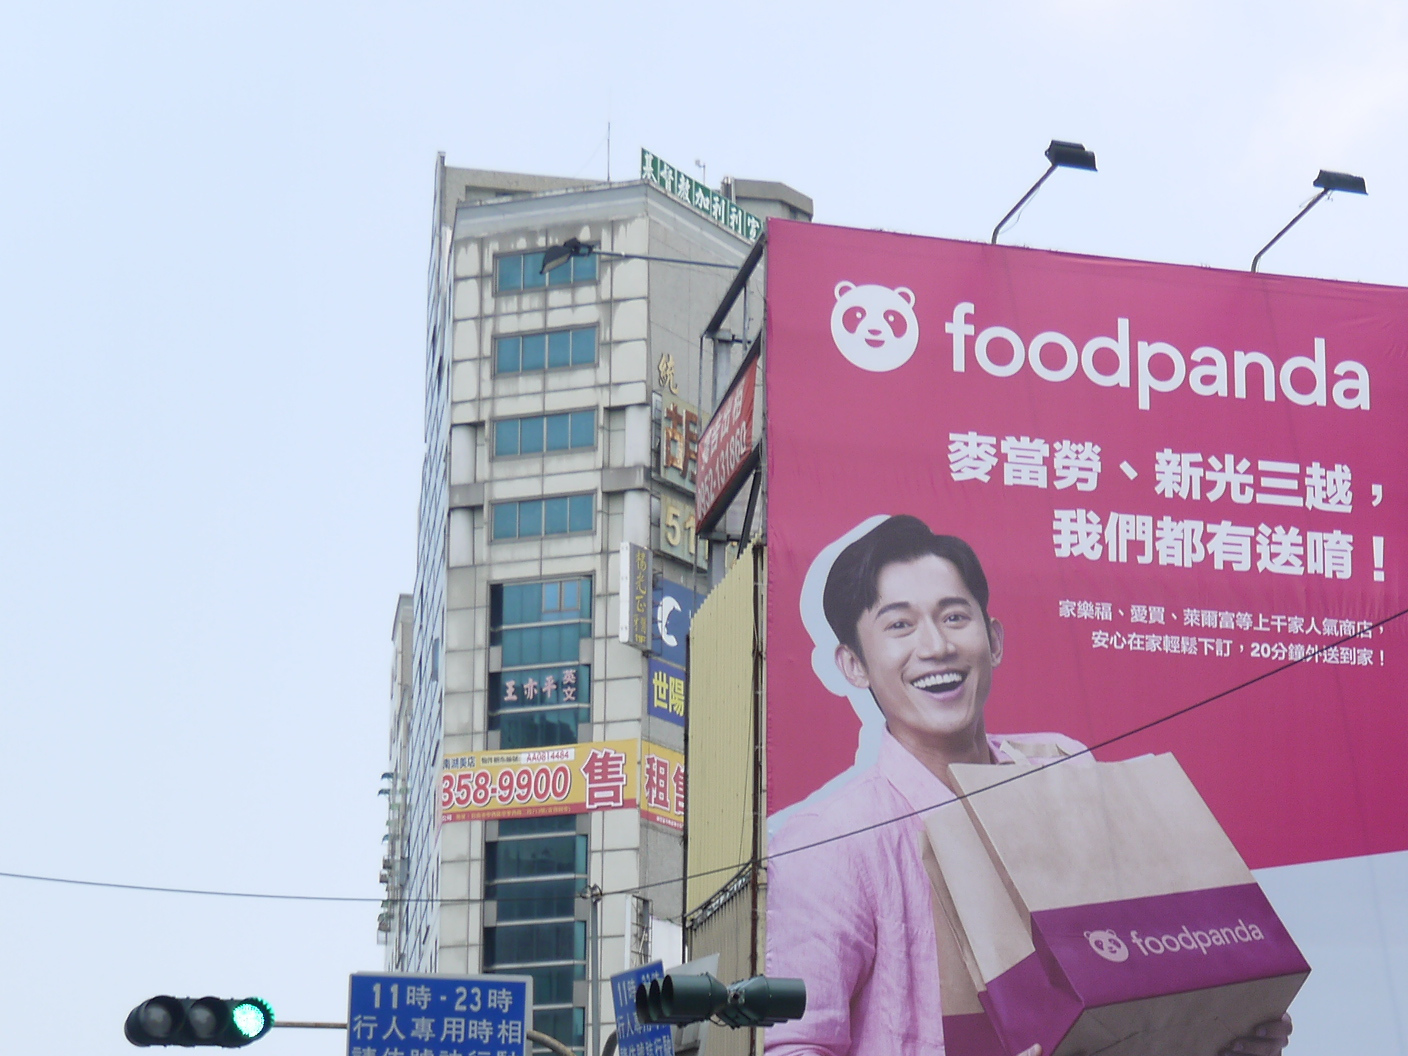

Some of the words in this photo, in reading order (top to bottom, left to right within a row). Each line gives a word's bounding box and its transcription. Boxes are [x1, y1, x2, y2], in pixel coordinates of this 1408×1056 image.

[945, 302, 1371, 410] foodpanda
[947, 432, 1384, 514] 麥當勞、新光三越，
[1052, 509, 1386, 583] 我們都有送唷！
[581, 749, 627, 809] 售
[1130, 919, 1265, 957] foodpanda
[352, 1013, 522, 1045] 行人專用時相
